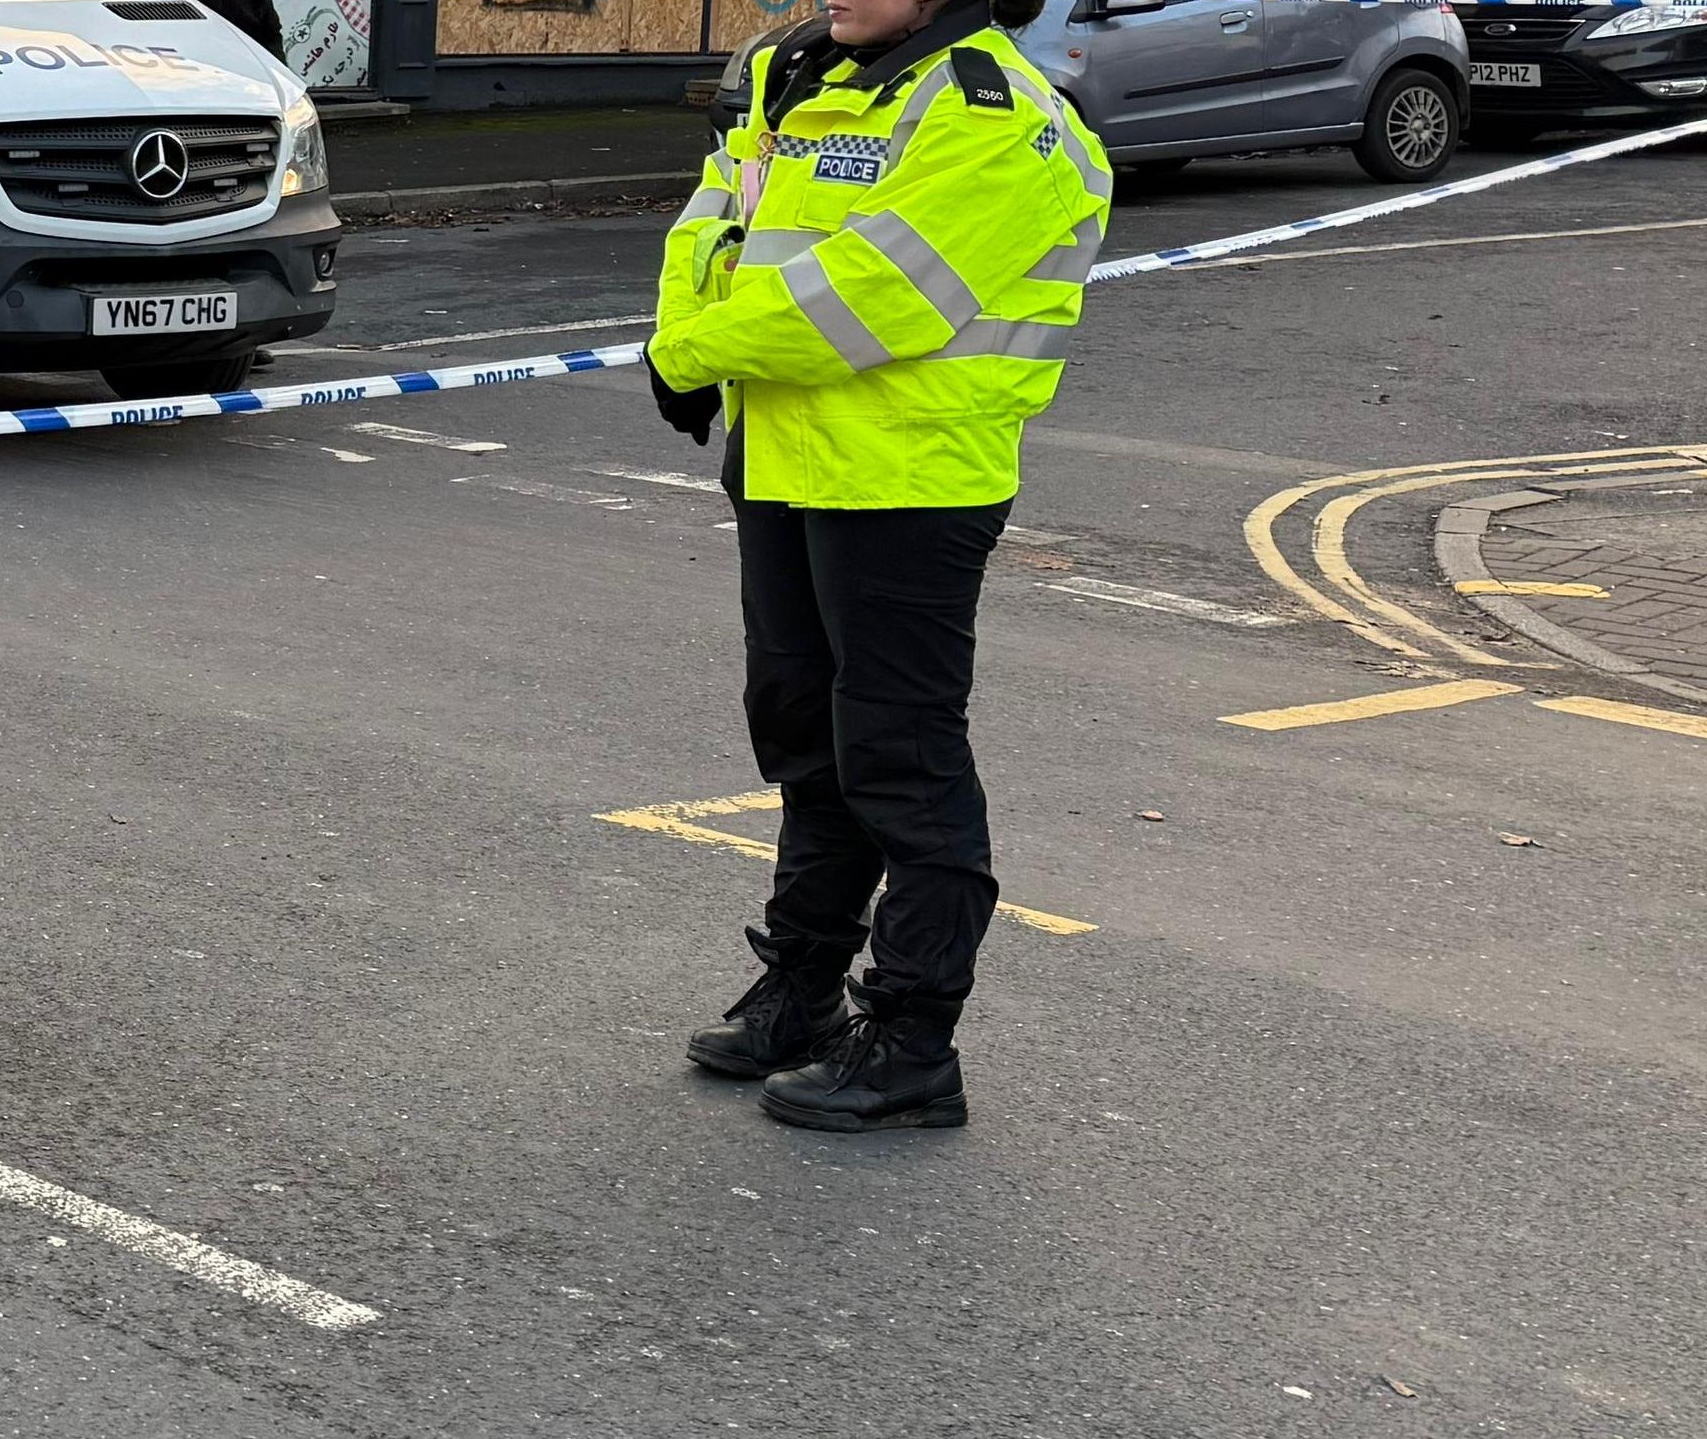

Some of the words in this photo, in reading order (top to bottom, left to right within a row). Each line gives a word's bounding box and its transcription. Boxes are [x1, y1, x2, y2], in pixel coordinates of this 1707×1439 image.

[1469, 64, 1497, 82] P12
[1498, 65, 1531, 83] PHZ
[818, 158, 876, 180] POLICE
[106, 298, 175, 329] YN67
[181, 295, 228, 326] CHG
